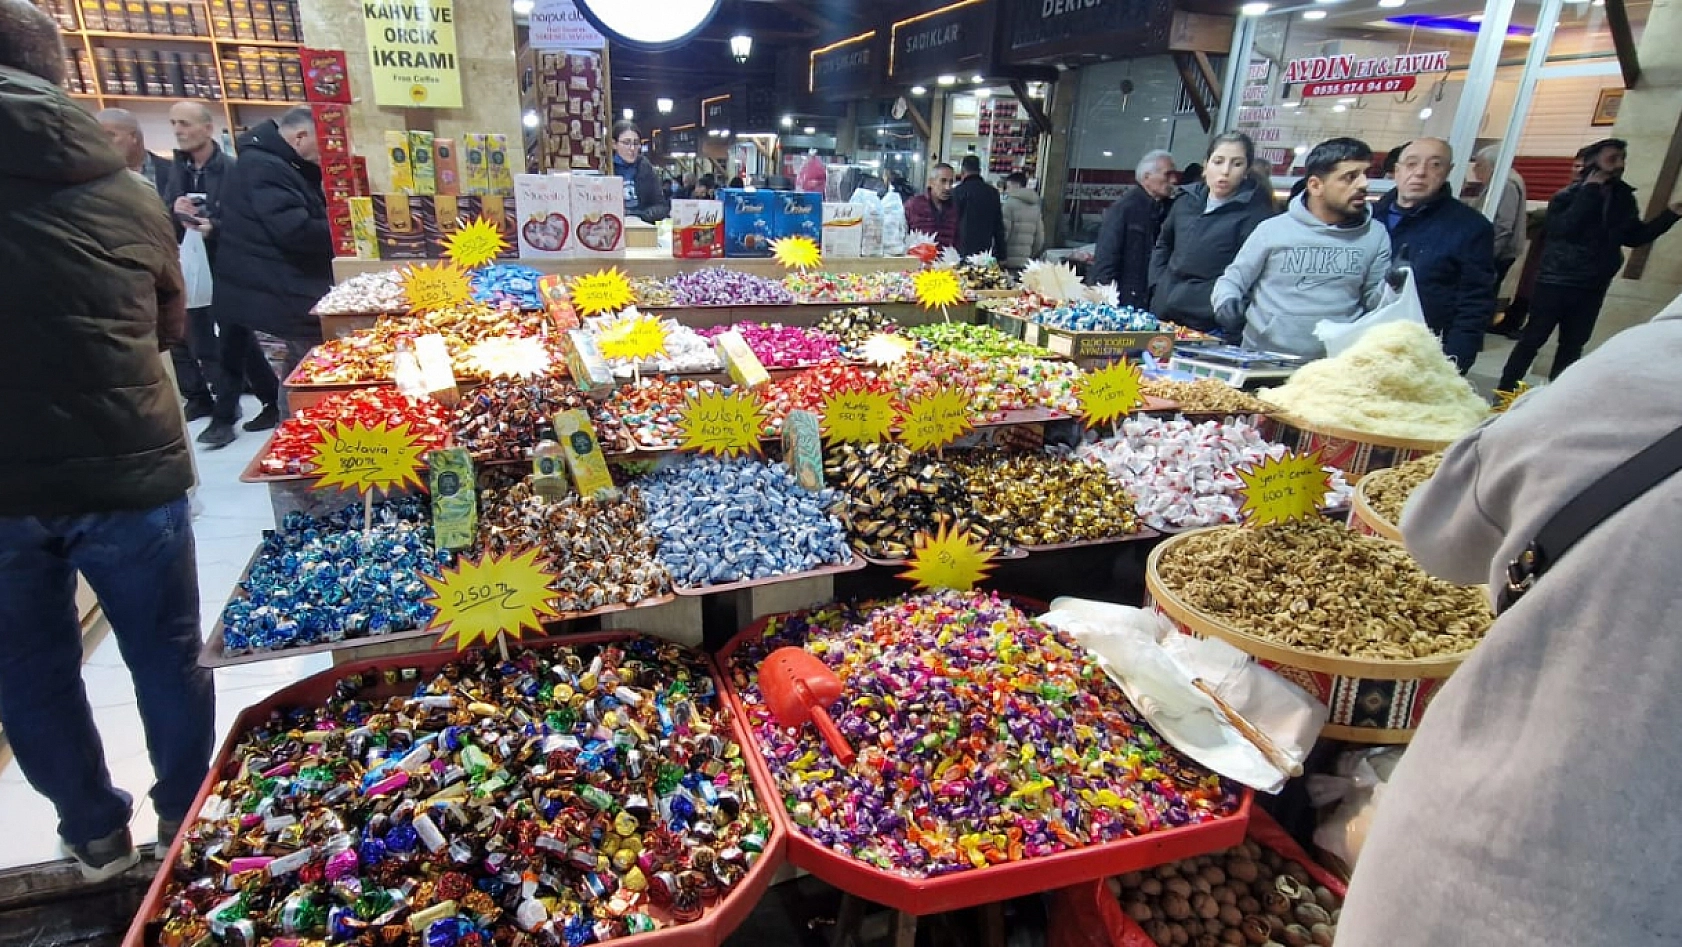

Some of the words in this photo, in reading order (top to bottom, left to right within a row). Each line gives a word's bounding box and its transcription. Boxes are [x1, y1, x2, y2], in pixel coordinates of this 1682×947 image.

[365, 3, 424, 21] KAHVE
[430, 7, 453, 23] VE
[906, 24, 958, 52] SADIKLAR
[372, 45, 455, 69] İKRAMI
[1284, 55, 1354, 82] AYDIN
[1356, 60, 1378, 77] ET
[1377, 58, 1390, 75] &
[1394, 52, 1449, 73] TAVUK
[1366, 81, 1382, 92] 94
[1385, 79, 1402, 91] 07
[1280, 247, 1363, 275] NIKE
[699, 405, 744, 422] Wish
[334, 438, 389, 455] Octavia
[453, 584, 491, 607] 250
